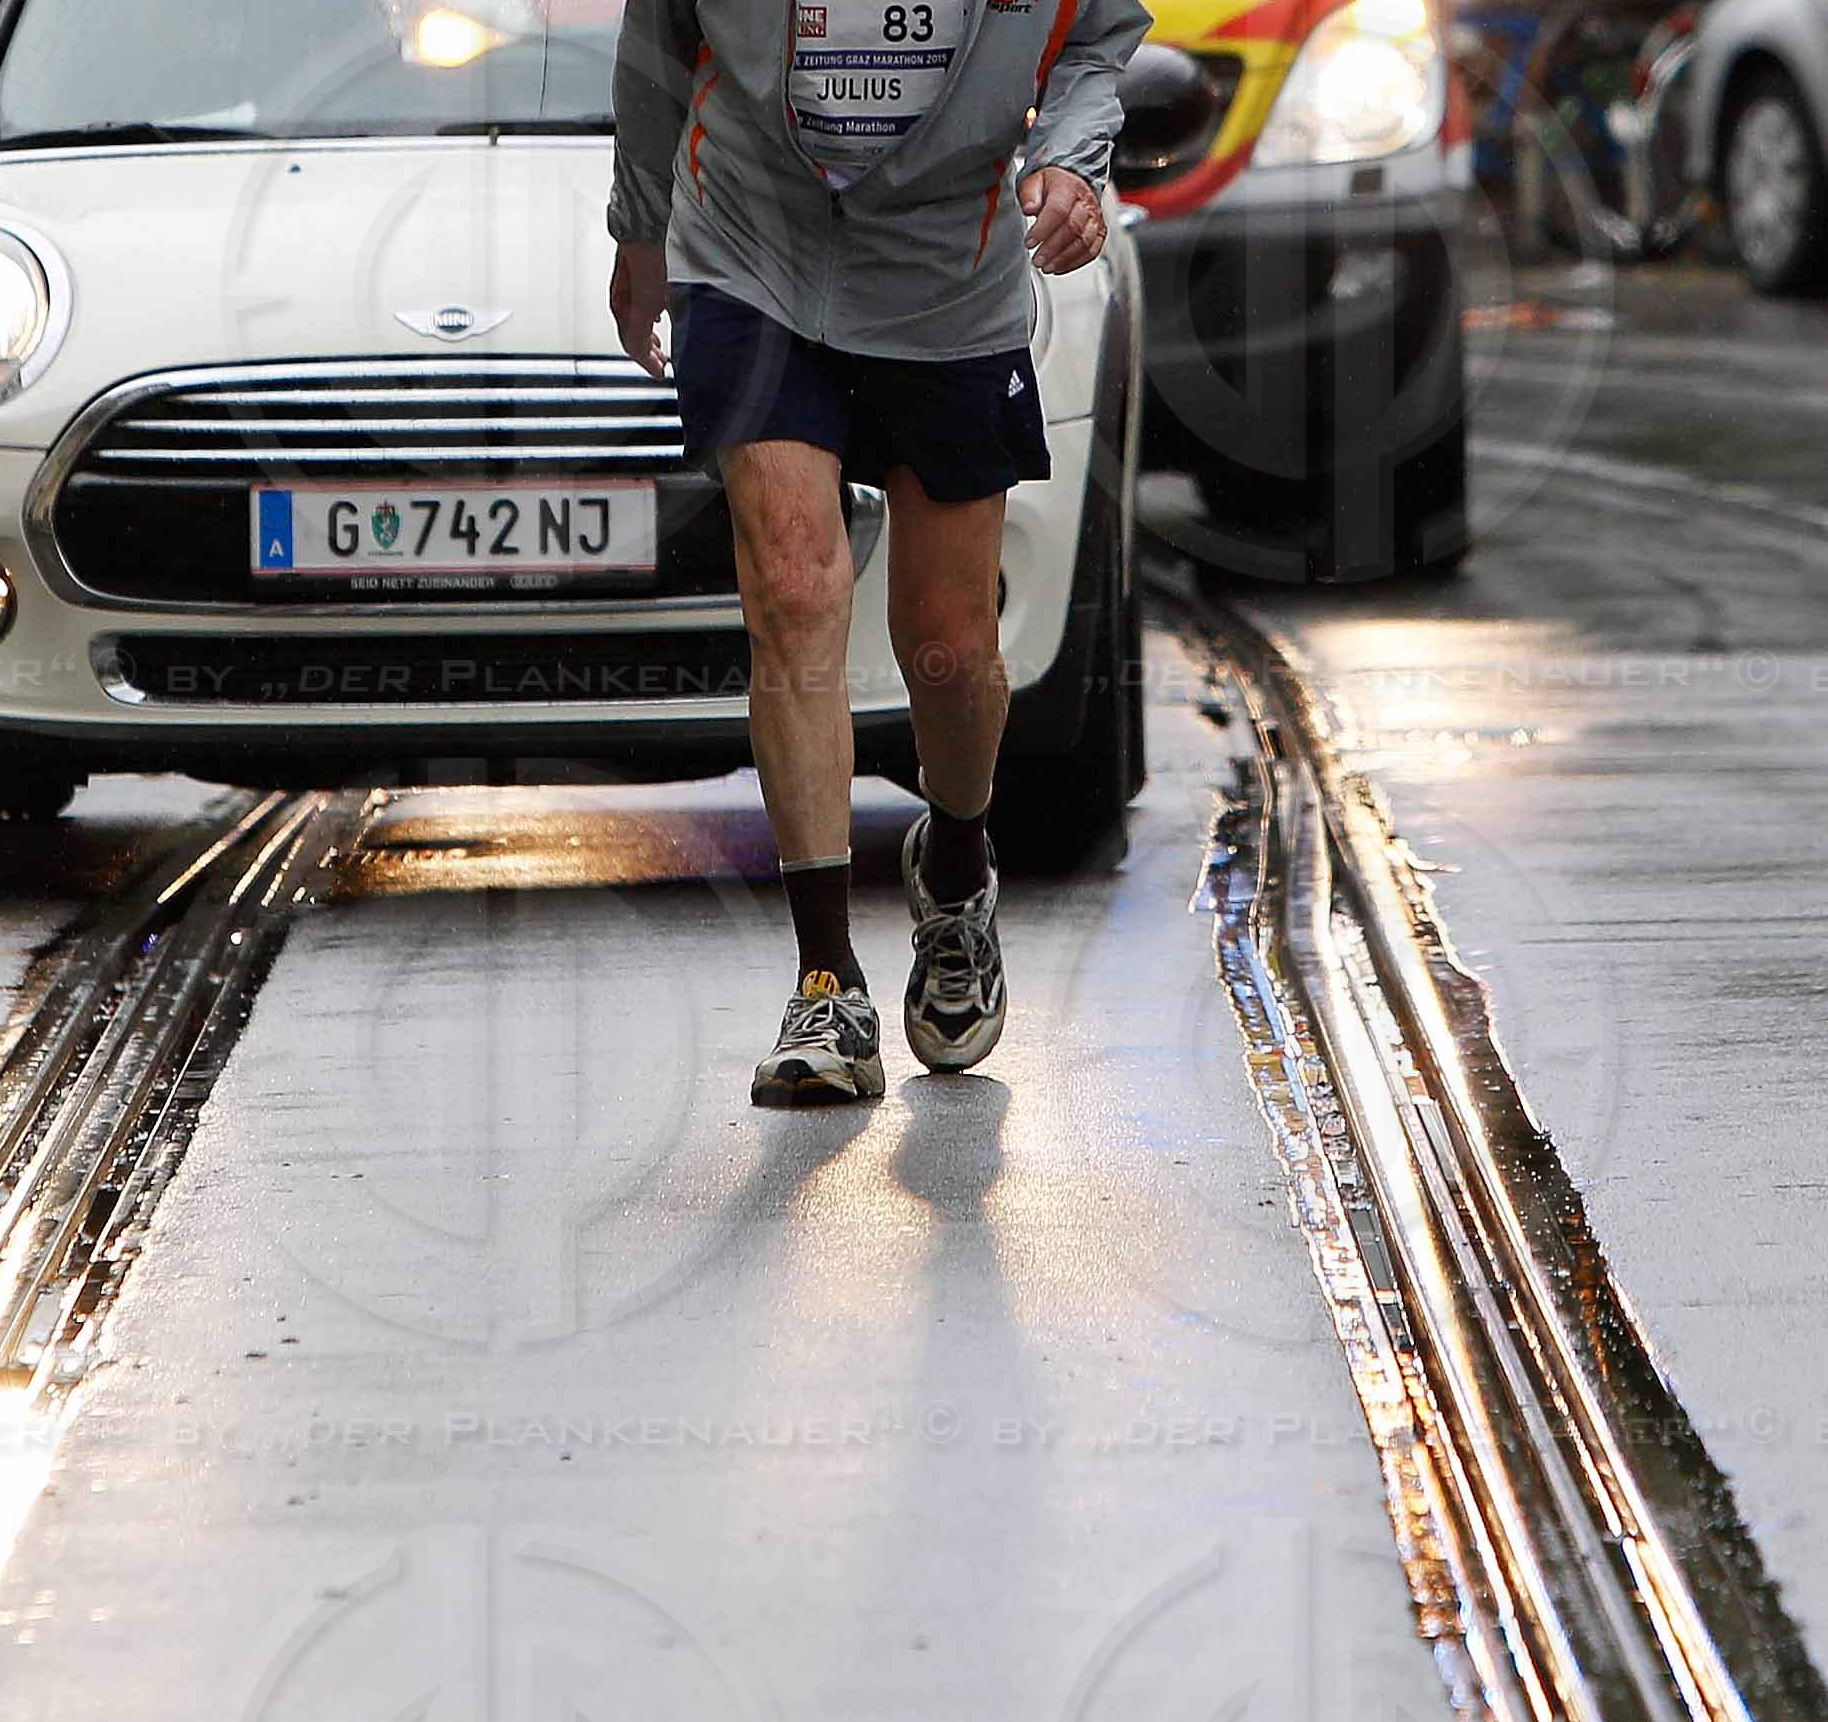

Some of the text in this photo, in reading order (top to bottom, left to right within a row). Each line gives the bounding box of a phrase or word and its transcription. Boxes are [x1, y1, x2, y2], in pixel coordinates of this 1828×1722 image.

[883, 4, 935, 43] 83
[804, 54, 843, 66] ZEITUNG
[845, 54, 870, 66] GRAZ
[873, 53, 923, 66] MARATHON
[926, 52, 948, 64] 2015
[816, 77, 902, 100] JULIUS
[845, 120, 896, 133] Marathon
[327, 497, 610, 556] G 742 NJ
[268, 538, 284, 557] A
